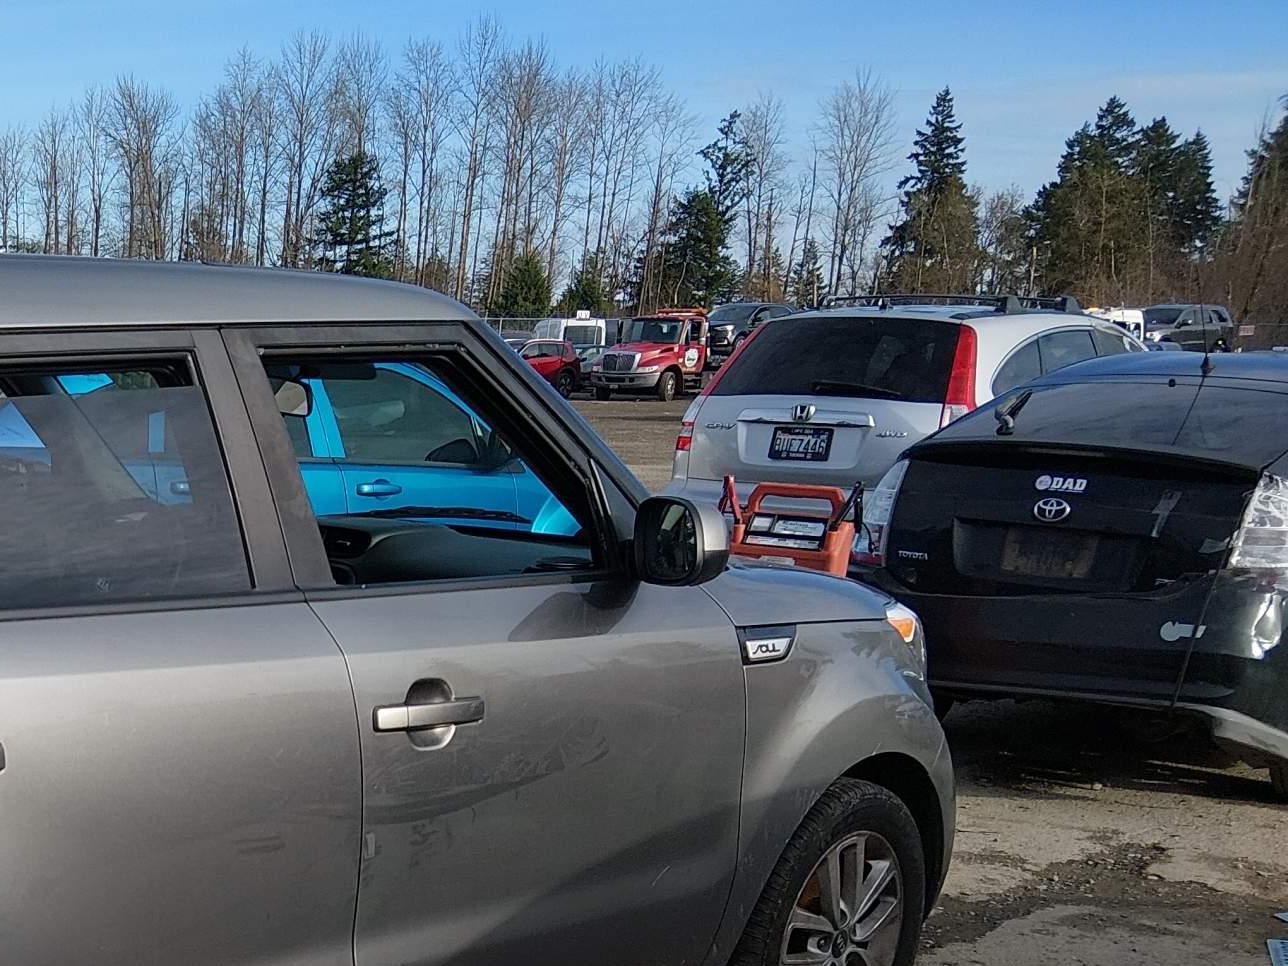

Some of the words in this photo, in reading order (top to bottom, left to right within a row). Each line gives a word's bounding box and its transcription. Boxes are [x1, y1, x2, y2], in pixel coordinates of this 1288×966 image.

[1050, 477, 1088, 491] DAD
[898, 550, 928, 560] TOYOTA
[752, 643, 781, 655] SOUL
